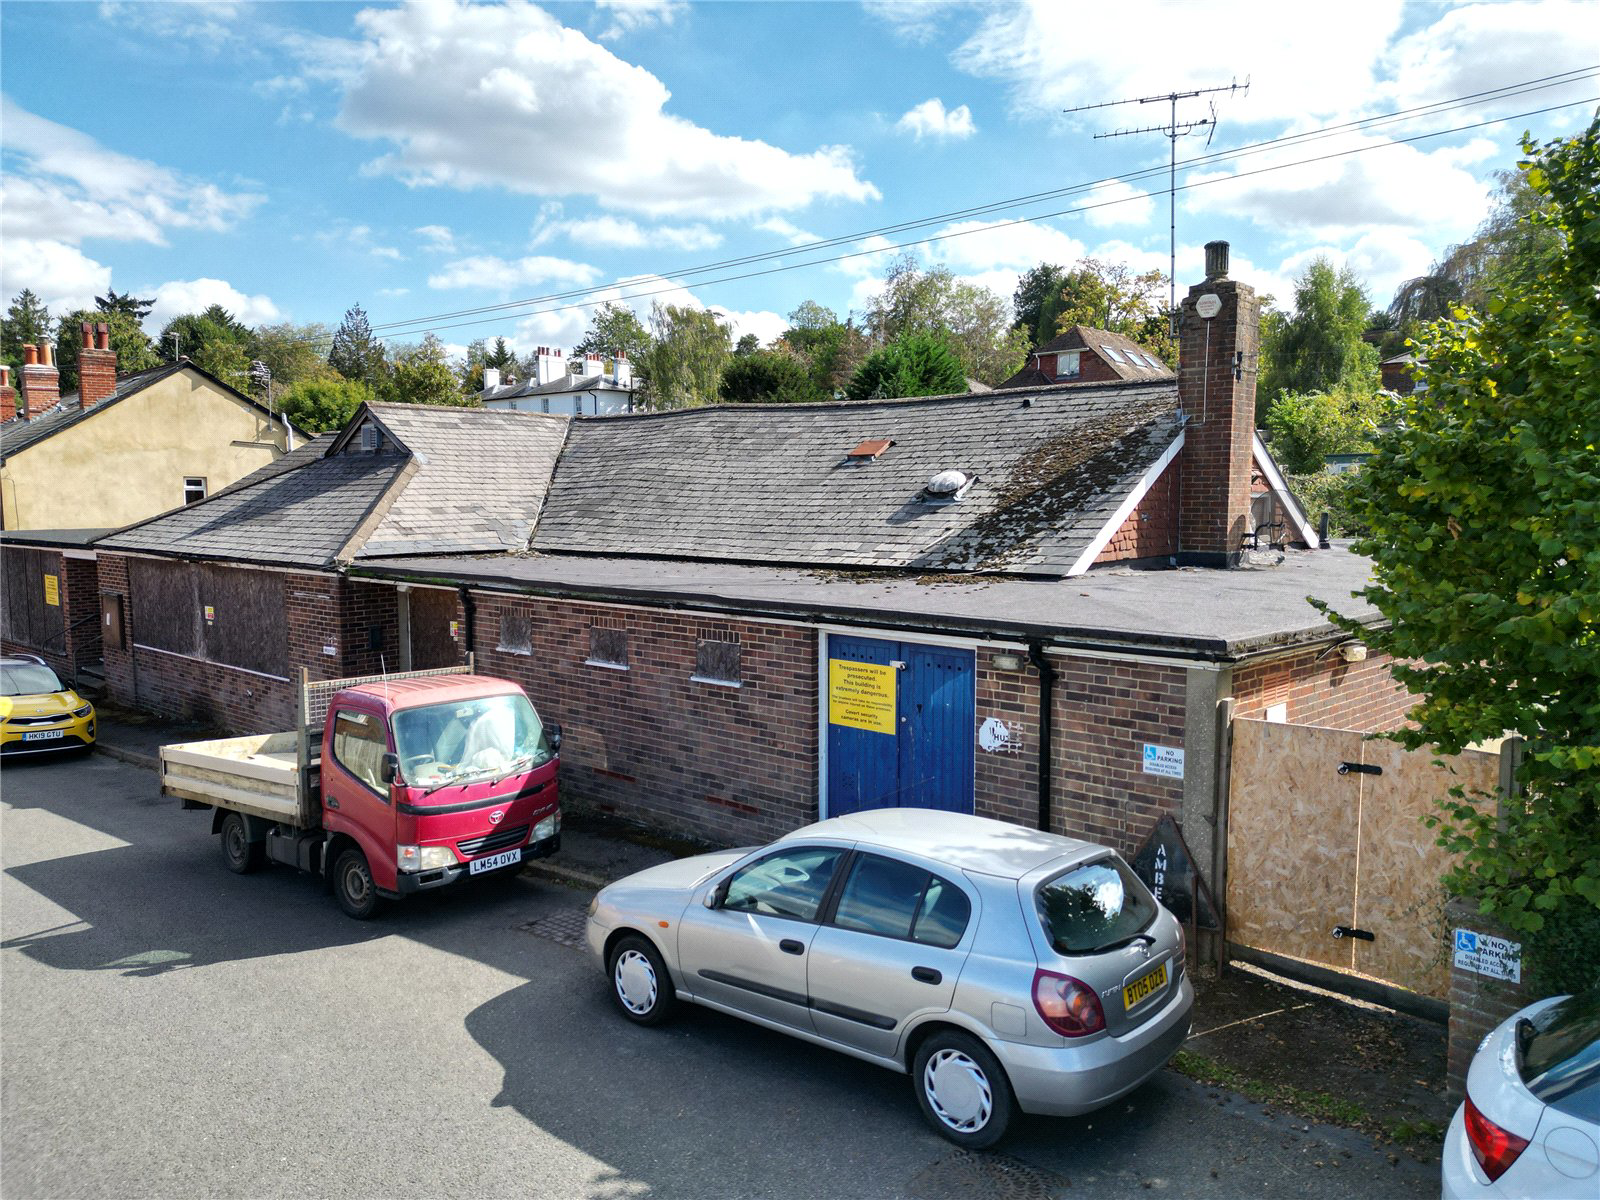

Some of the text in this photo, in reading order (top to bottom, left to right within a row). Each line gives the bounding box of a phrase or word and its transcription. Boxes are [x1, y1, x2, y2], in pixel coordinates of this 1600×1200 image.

[839, 664, 868, 673] Trespassers
[835, 686, 860, 694] extremely
[855, 682, 875, 690] building
[1157, 756, 1182, 764] PARKING
[473, 853, 517, 872] LM54 OVX
[1491, 941, 1505, 950] NO
[1126, 982, 1149, 1005] BT05
